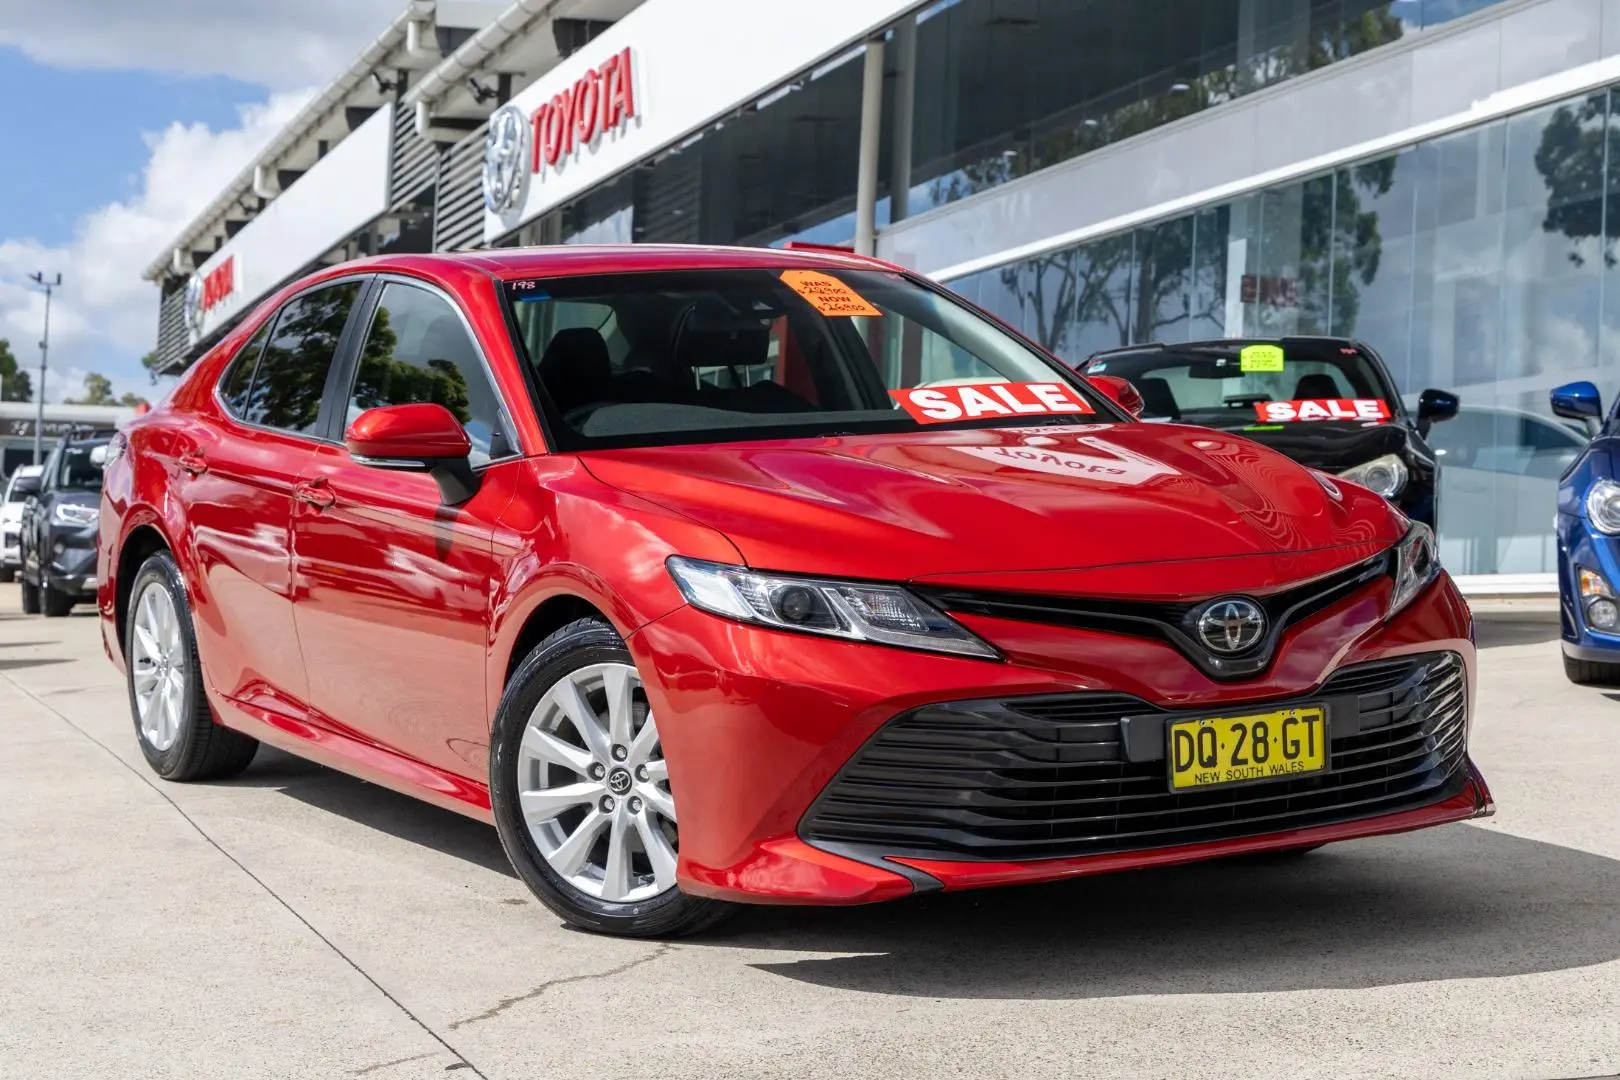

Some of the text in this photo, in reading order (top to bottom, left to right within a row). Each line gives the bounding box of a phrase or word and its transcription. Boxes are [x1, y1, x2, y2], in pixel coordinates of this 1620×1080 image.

[530, 46, 634, 174] TOYOTA
[908, 383, 1082, 420] SALE
[1265, 400, 1385, 420] SALE
[1195, 760, 1305, 784] NEW SOUTH WALES
